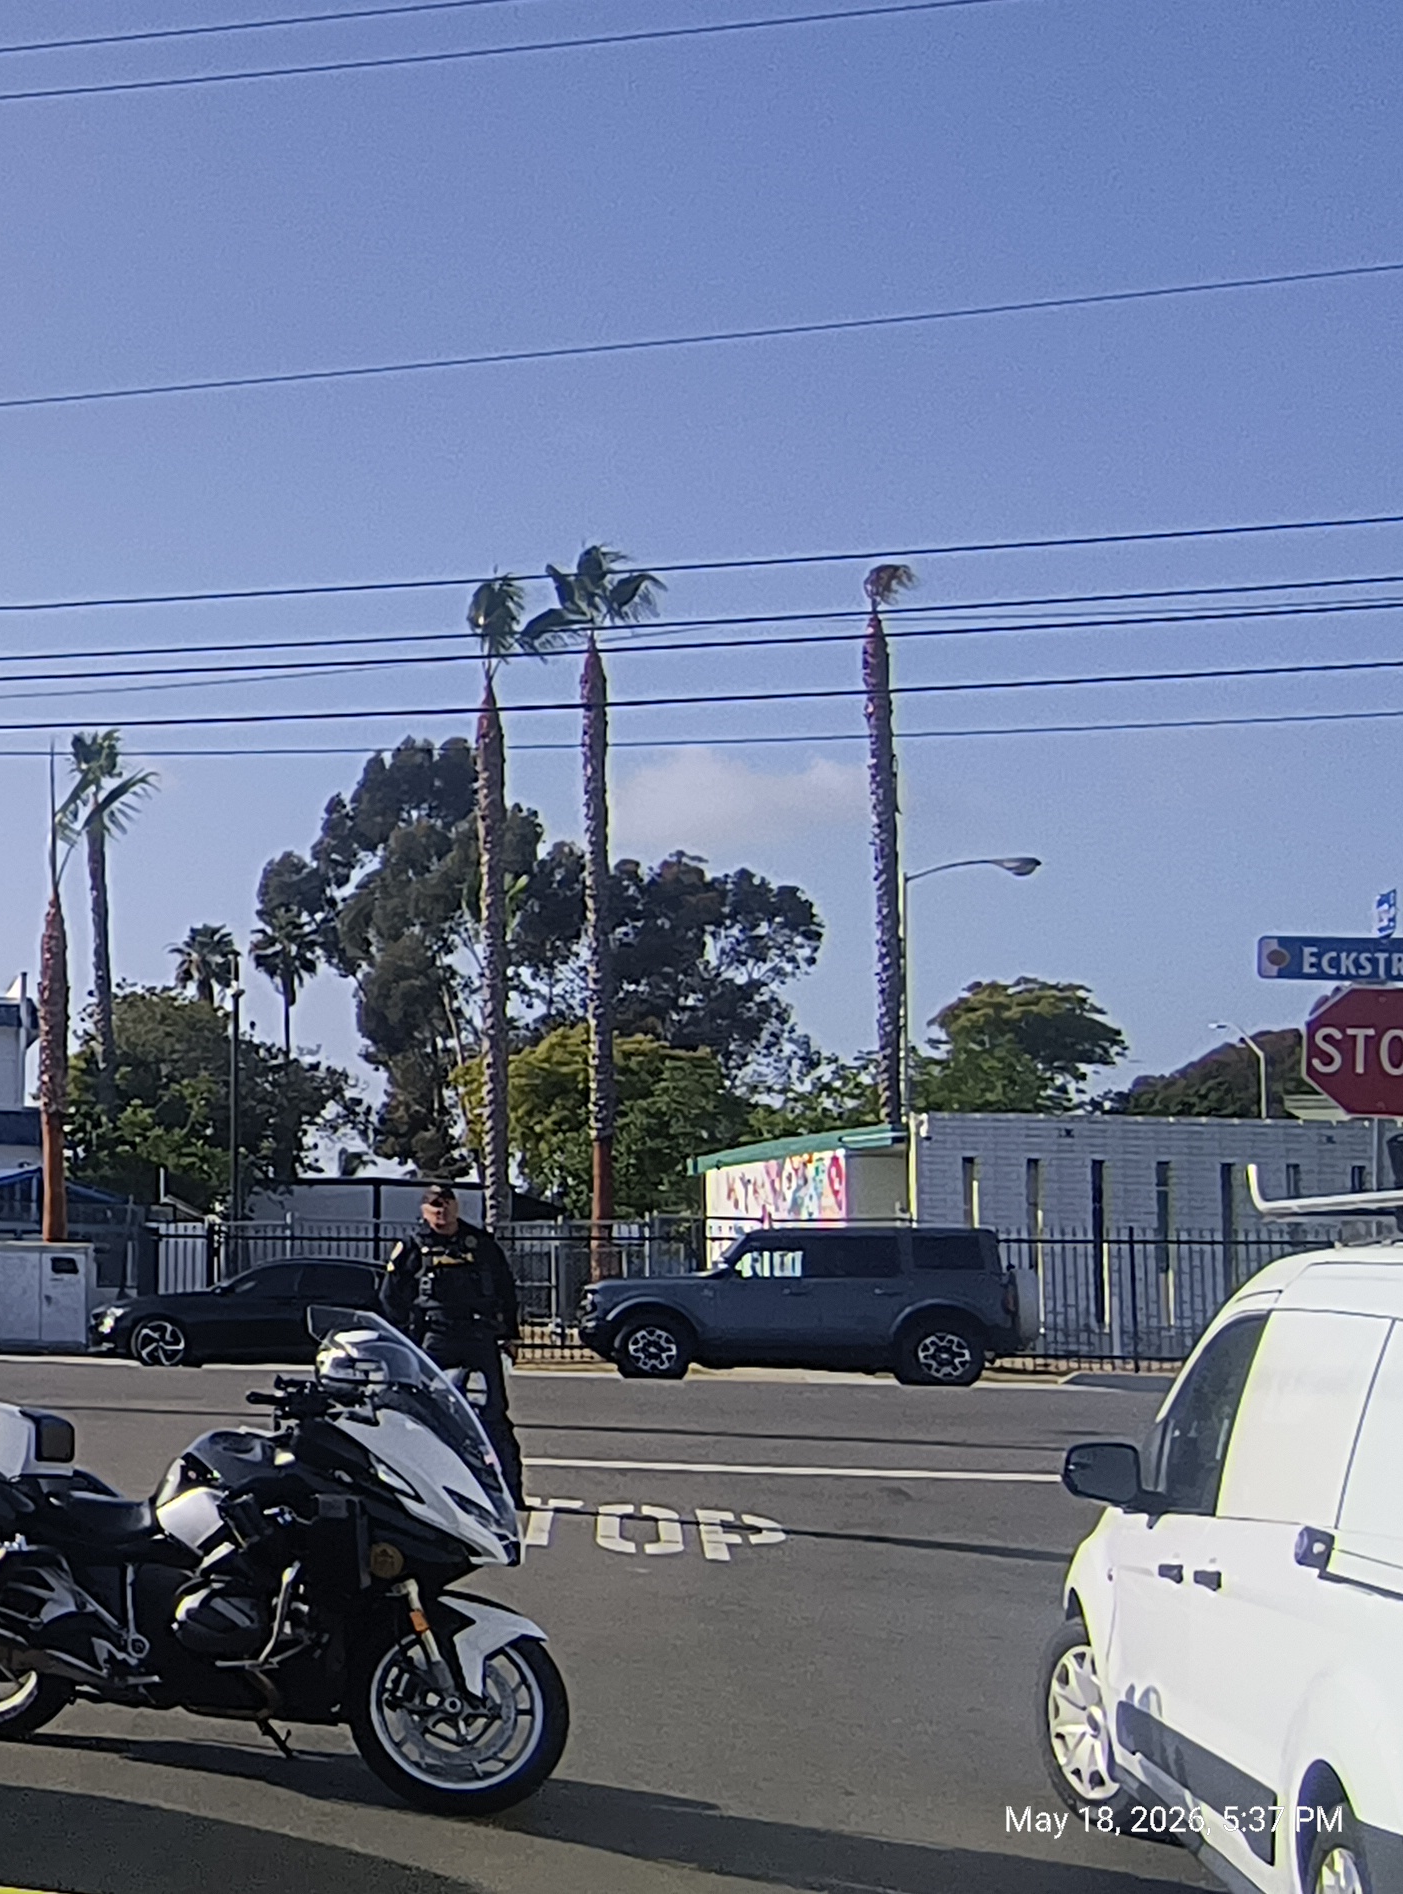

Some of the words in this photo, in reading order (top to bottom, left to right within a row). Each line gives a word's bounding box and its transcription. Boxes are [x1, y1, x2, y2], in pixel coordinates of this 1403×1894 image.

[1302, 946, 1403, 979] ECKSTR
[1312, 1026, 1403, 1075] STO
[523, 1497, 787, 1562] TOP
